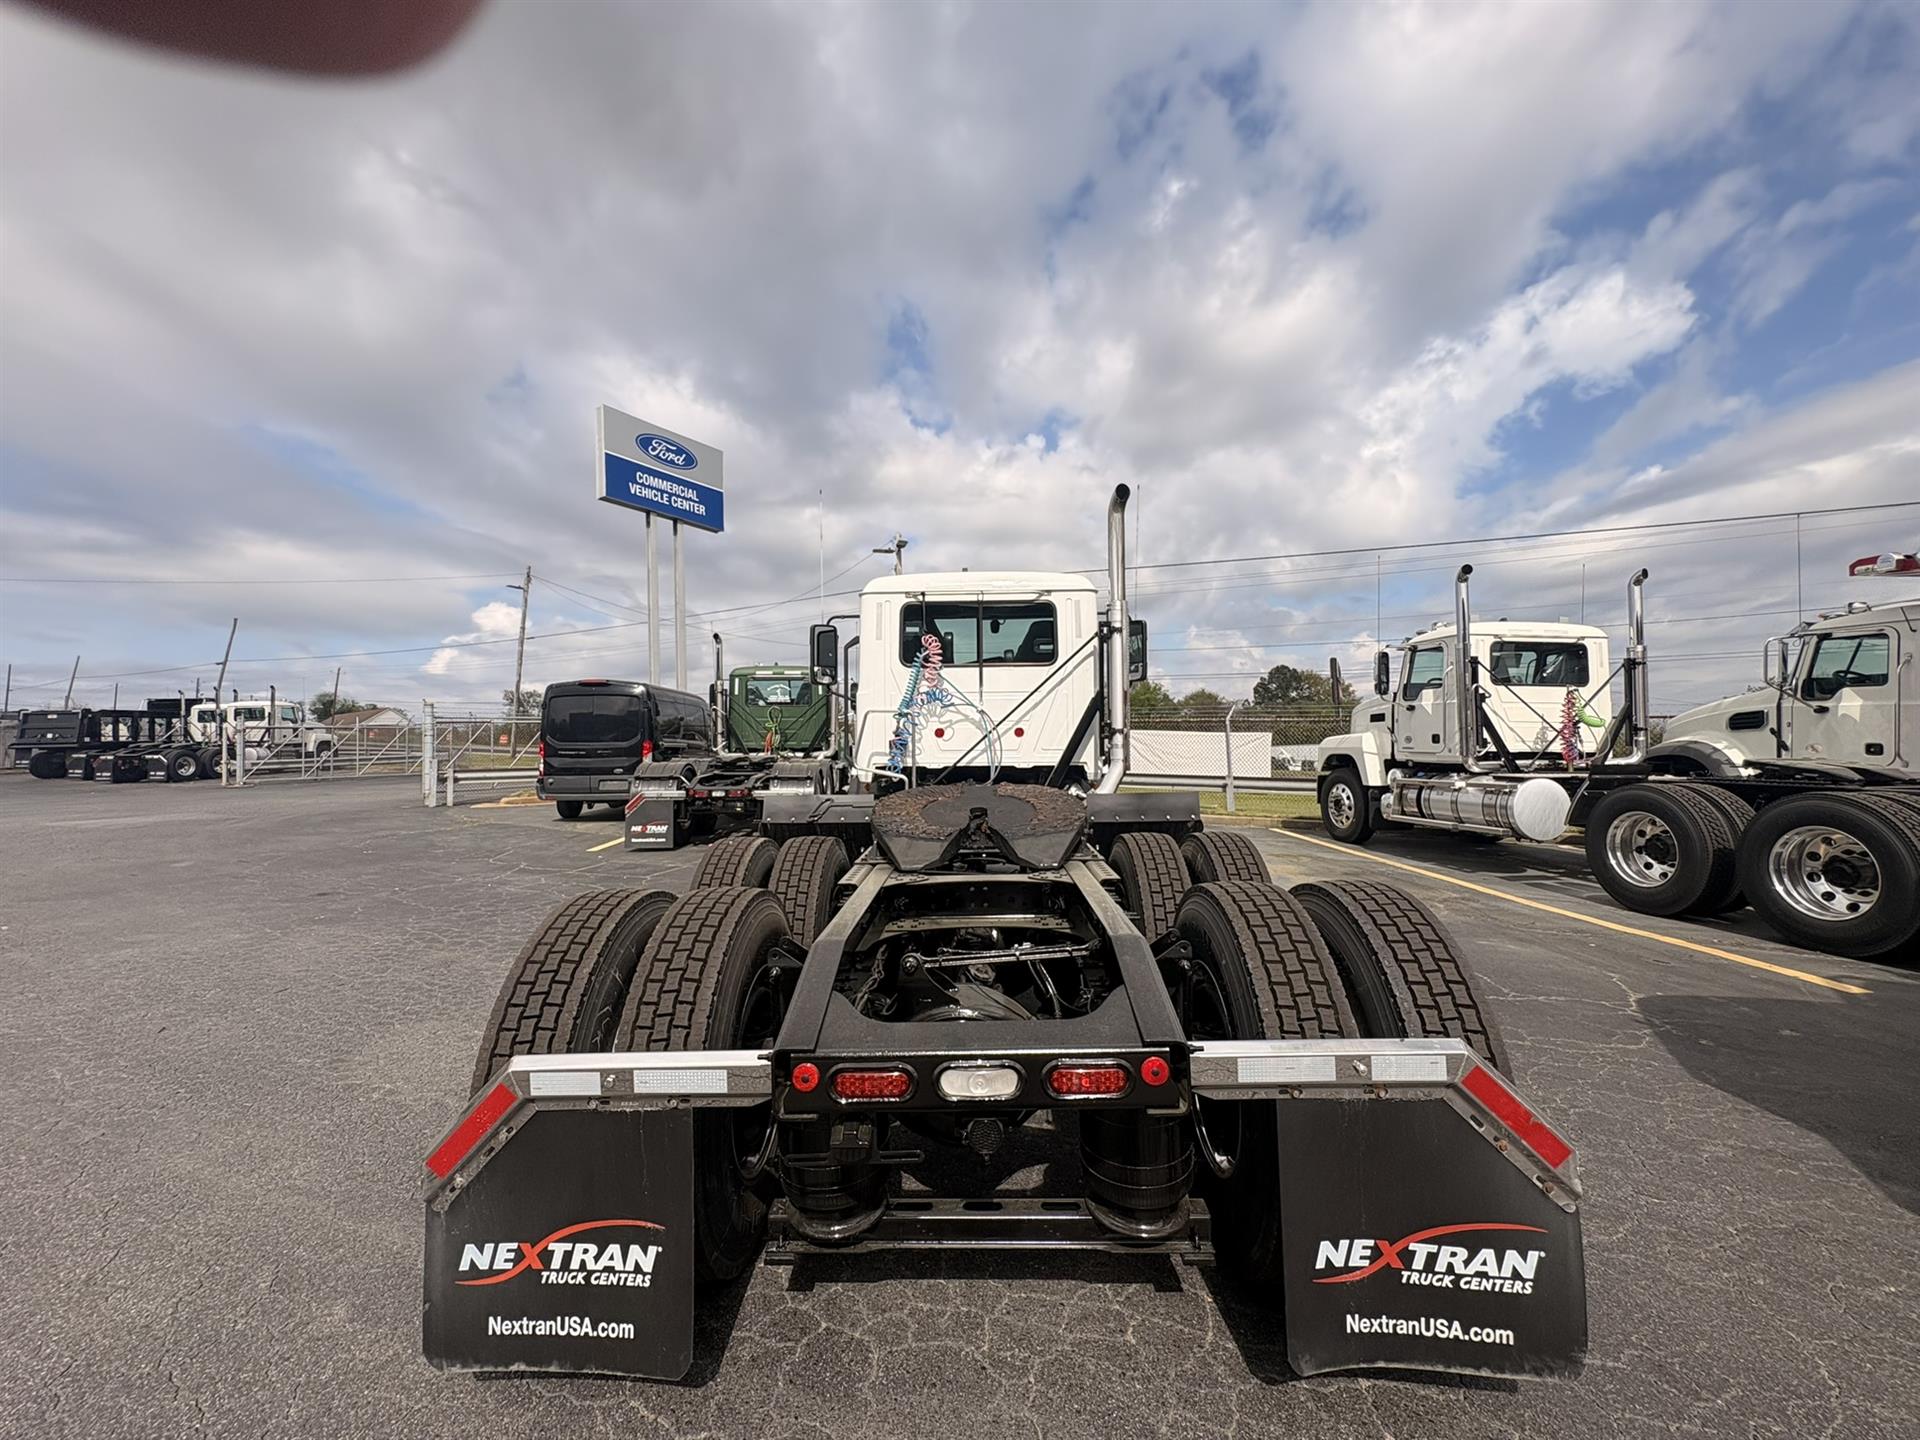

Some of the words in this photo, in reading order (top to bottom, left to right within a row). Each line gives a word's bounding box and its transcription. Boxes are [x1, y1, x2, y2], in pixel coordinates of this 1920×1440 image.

[648, 438, 687, 466] Ford
[628, 482, 670, 505] VEHICLE
[671, 496, 706, 516] CENTER
[635, 471, 700, 502] COMMERCIAL
[458, 1242, 658, 1274] NEXTRAN
[1314, 1238, 1540, 1280] NEXTRAN
[540, 1271, 587, 1286] TRUCK
[590, 1272, 652, 1288] CENTERS
[1400, 1271, 1455, 1289] TRUCK
[1459, 1275, 1534, 1295] CENTERS
[487, 1315, 635, 1340] NextranUSA.com
[1345, 1313, 1515, 1346] NextranUSA.com
